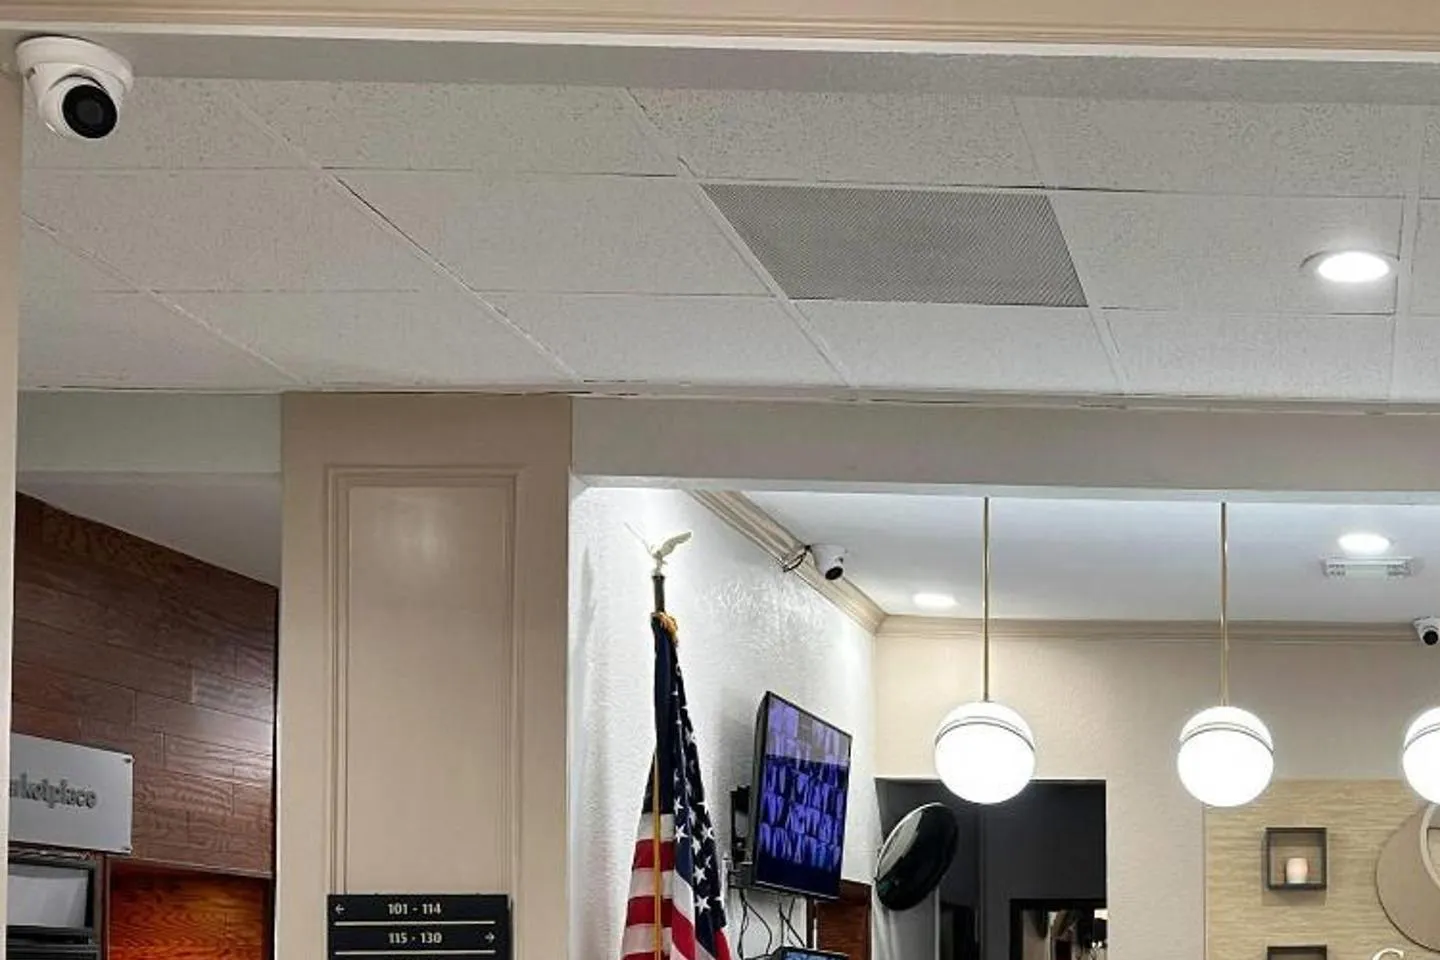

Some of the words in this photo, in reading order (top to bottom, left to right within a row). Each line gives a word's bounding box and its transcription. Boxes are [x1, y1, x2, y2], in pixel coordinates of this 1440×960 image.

[388, 902, 408, 915] 101
[422, 902, 442, 915] 114
[388, 932, 408, 944] 115
[420, 932, 443, 944] 130
